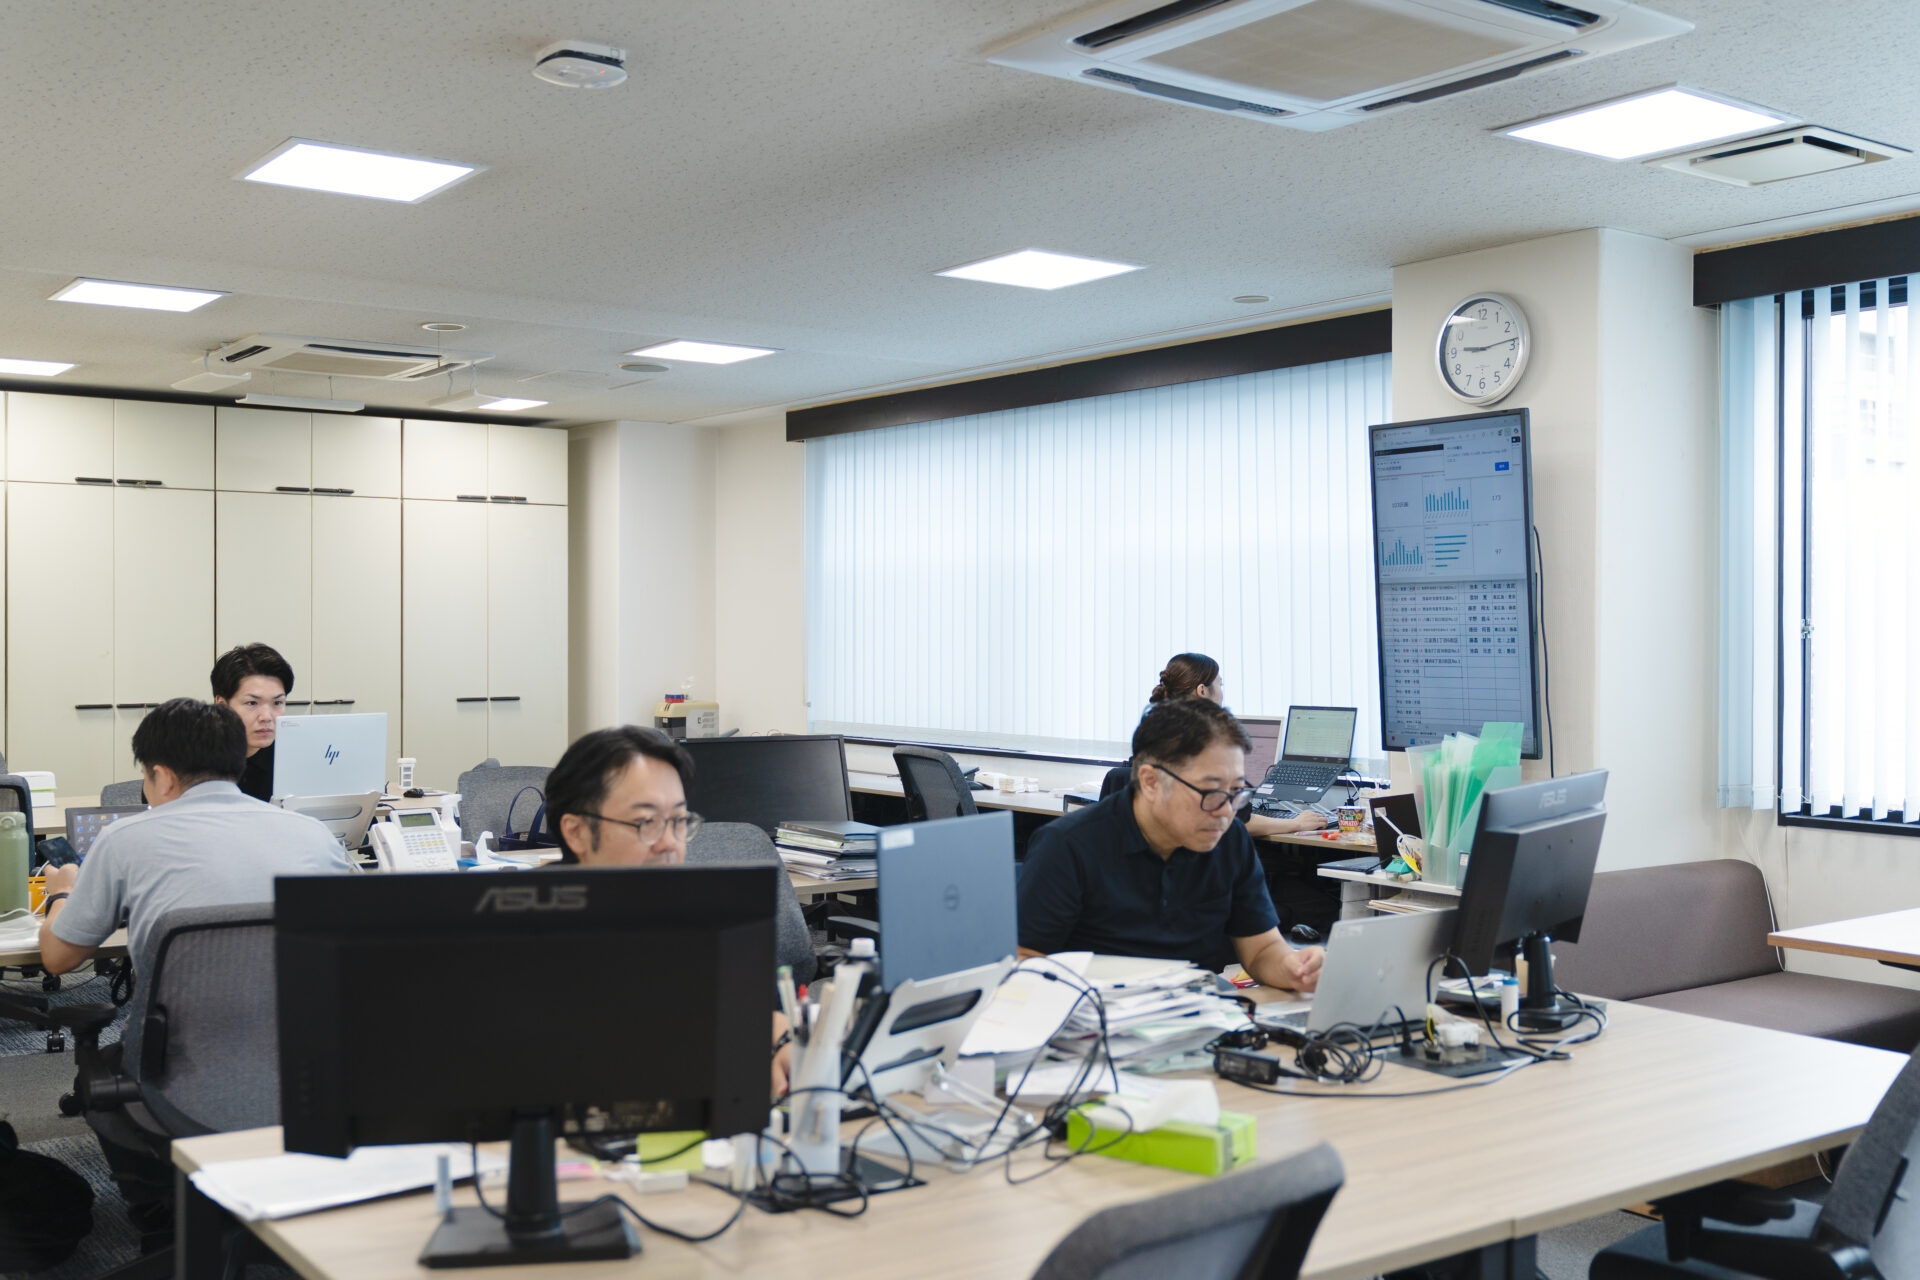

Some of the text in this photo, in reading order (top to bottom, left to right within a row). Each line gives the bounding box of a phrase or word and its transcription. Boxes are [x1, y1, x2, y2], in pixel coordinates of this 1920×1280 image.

[1478, 308, 1488, 320] 12
[1495, 311, 1499, 323] 1
[1504, 321, 1511, 333] 2
[1508, 339, 1516, 351] 3
[1450, 347, 1457, 359] 9
[1503, 357, 1511, 369] 4
[1454, 363, 1462, 376] 8
[1466, 374, 1472, 386] 7
[1494, 371, 1501, 383] 5
[1479, 378, 1486, 390] 6
[325, 744, 340, 765] hp
[1539, 787, 1567, 809] ASUS
[474, 886, 587, 913] ASUS
